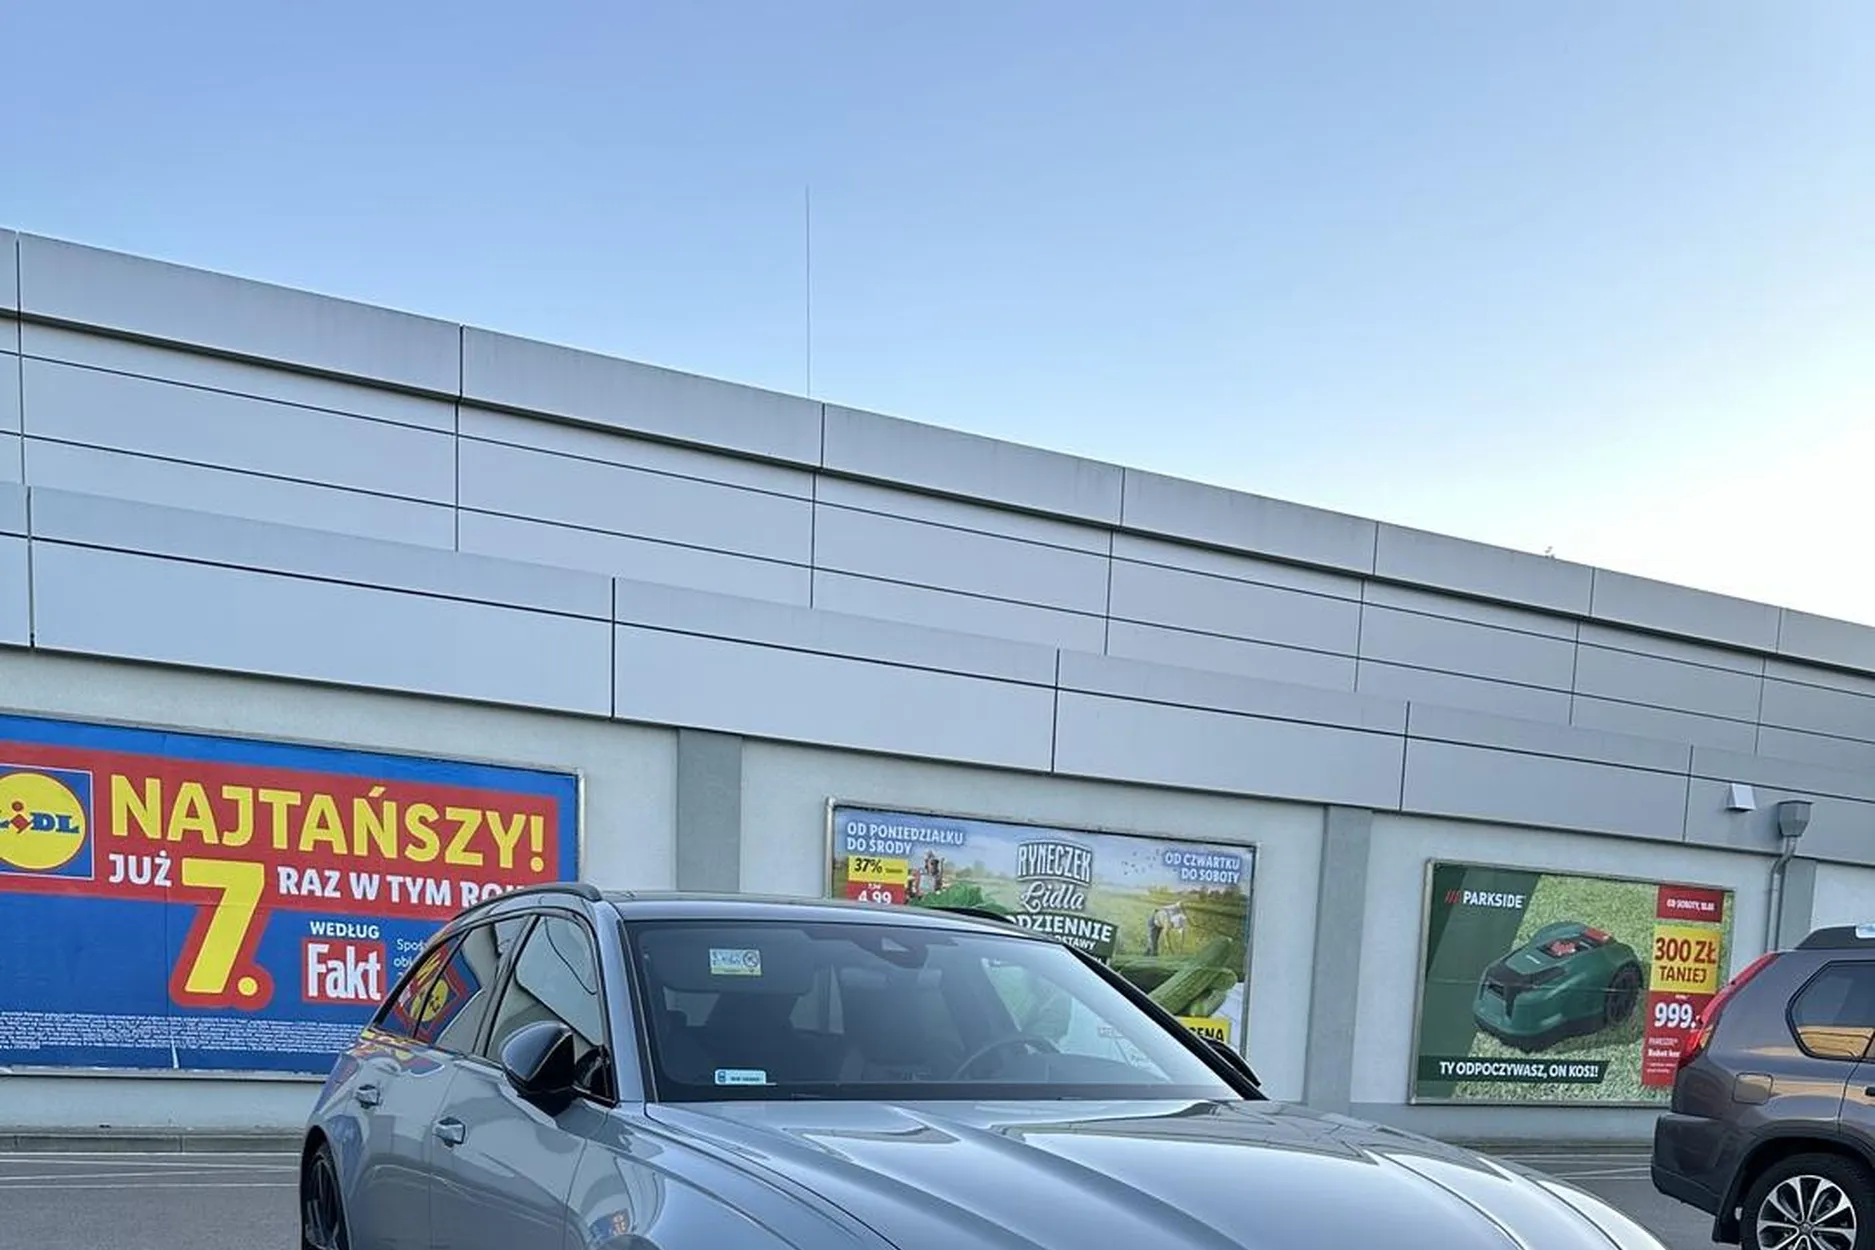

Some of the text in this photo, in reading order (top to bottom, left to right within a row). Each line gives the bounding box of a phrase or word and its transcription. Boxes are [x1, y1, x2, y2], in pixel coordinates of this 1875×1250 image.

[110, 773, 545, 873] NAJTAŃSZY!
[847, 821, 964, 845] OD PONIEDZIAŁKU
[847, 836, 912, 855] DO ŚRODY
[854, 857, 883, 874] 37%
[1018, 843, 1092, 883] RYNECZEK
[1165, 852, 1181, 865] OD
[1181, 867, 1198, 880] DO
[1020, 881, 1086, 914] Lidla
[1462, 891, 1524, 909] PARKSIDE
[108, 850, 526, 998] JUŻ 7. RAZ W TYM RO
[310, 921, 381, 940] WEDŁUG
[1655, 937, 1717, 964] 300 ZŁ
[307, 942, 382, 1001] Fakt
[1658, 965, 1707, 984] TANIEJ
[1440, 1061, 1456, 1075] TY
[1455, 1061, 1548, 1079] ODPOCZYWASZ,
[1549, 1064, 1567, 1078] ON
